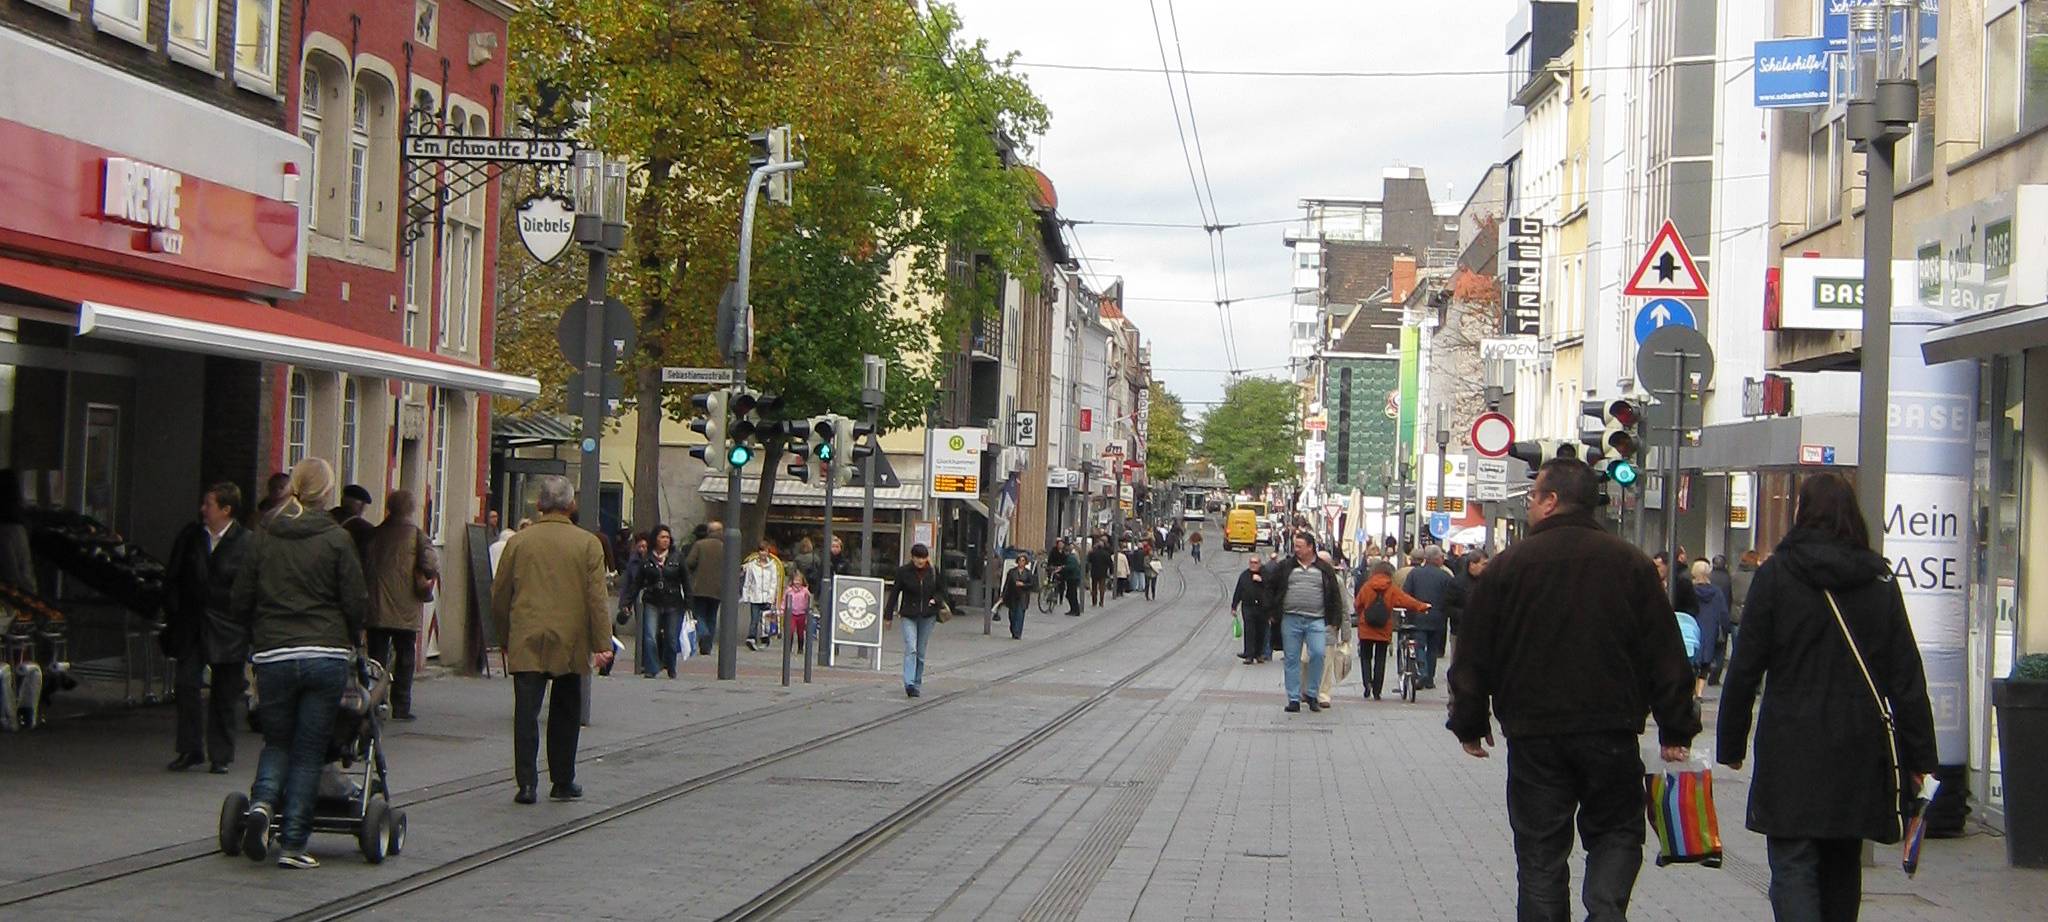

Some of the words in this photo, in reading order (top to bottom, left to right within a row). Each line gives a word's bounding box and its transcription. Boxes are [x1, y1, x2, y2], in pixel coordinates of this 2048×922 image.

[413, 139, 441, 154] Em
[112, 157, 182, 230] REWE
[1987, 231, 2009, 270] BASE
[1820, 283, 1865, 303] BAS
[1483, 343, 1536, 357] MODEN
[1888, 402, 1963, 432] BASE
[1105, 442, 1122, 454] dm
[1884, 503, 1958, 537] Mein
[1885, 556, 1962, 590] ASE.
